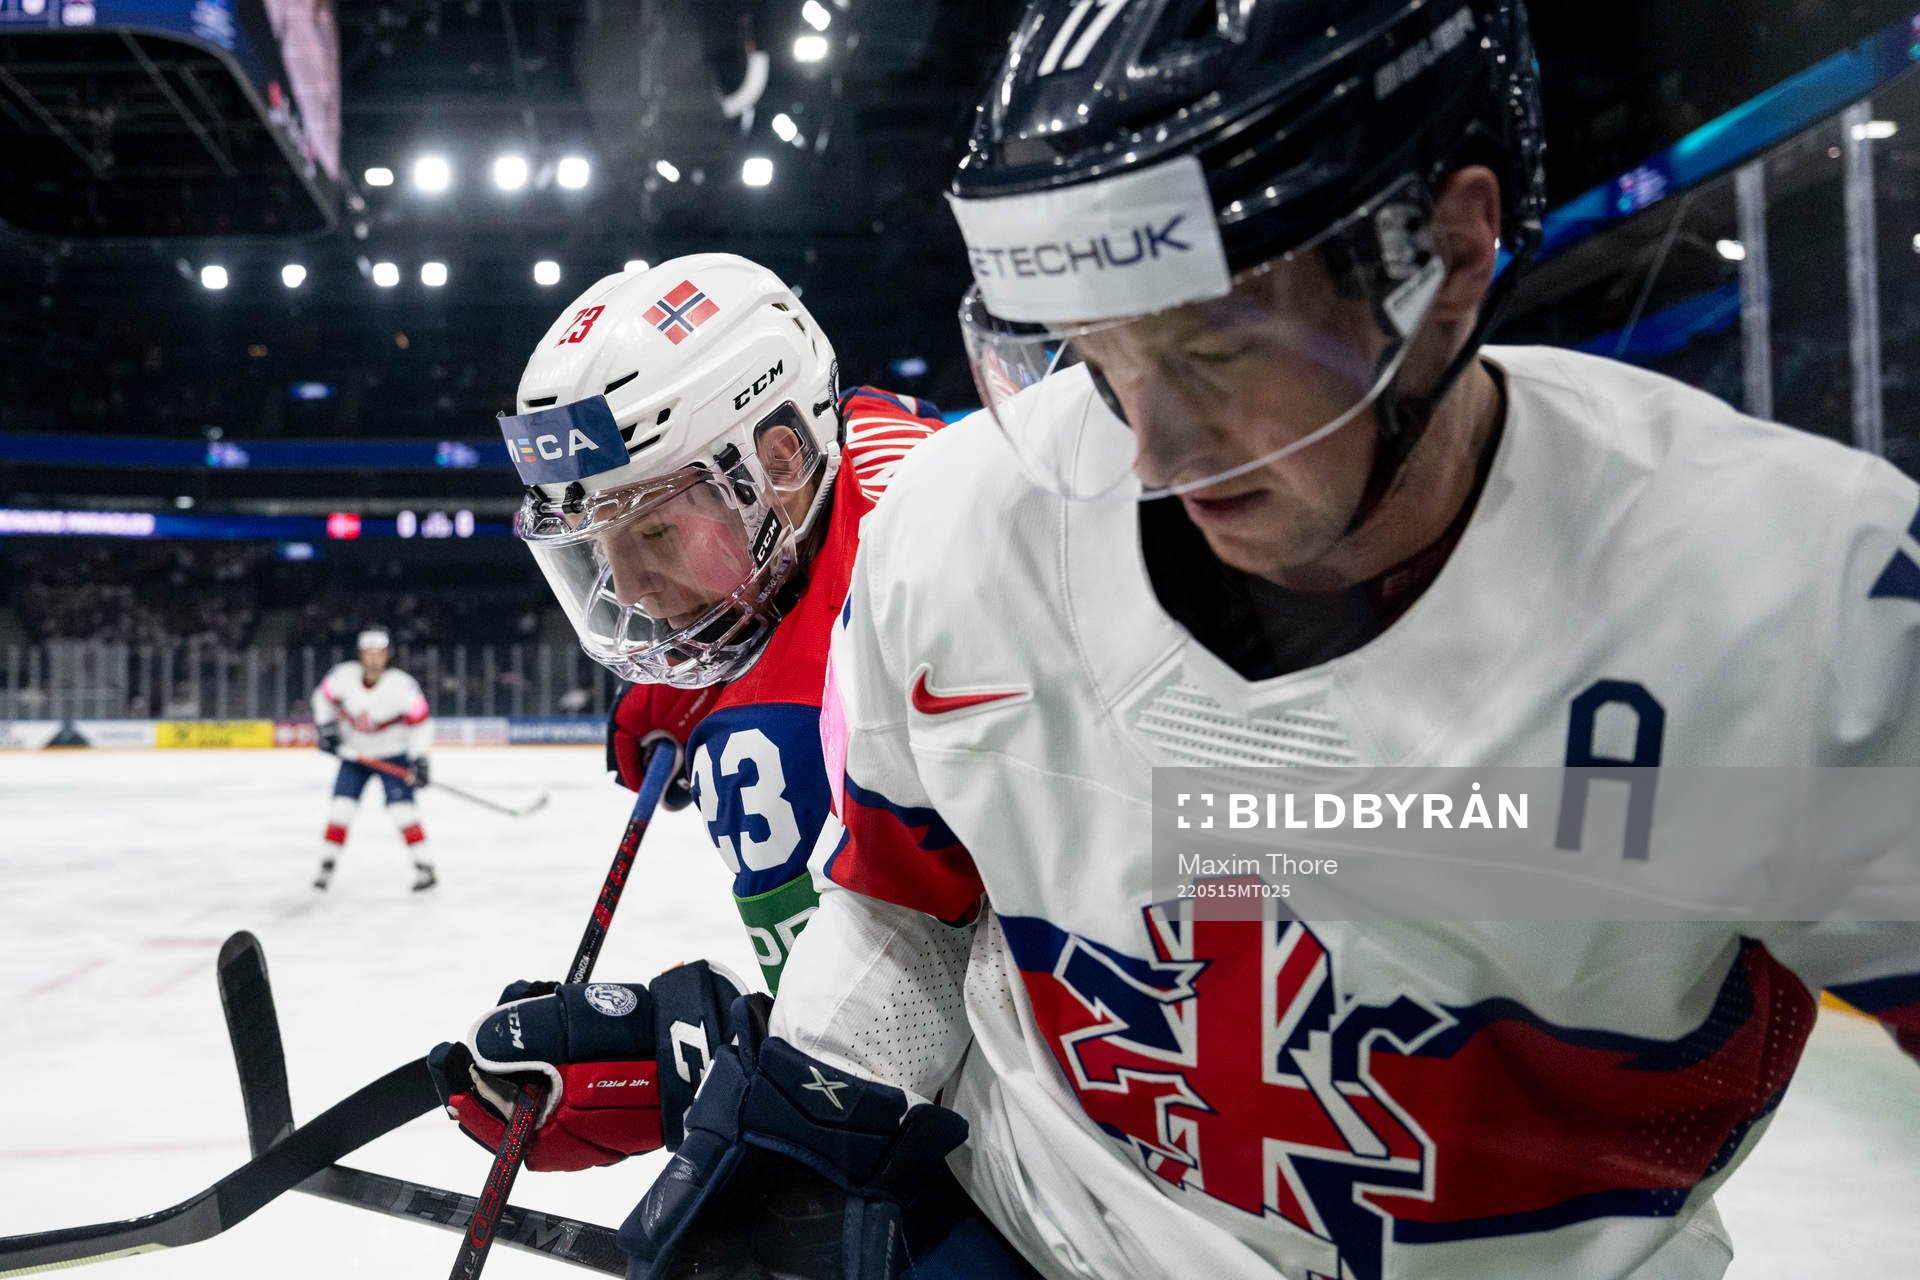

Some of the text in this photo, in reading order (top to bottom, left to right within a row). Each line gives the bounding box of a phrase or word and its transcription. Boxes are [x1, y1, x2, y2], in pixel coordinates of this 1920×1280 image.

[733, 359, 783, 410] CCM
[757, 518, 778, 562] CCM
[1555, 678, 1667, 862] A
[690, 728, 801, 874] 23
[507, 1005, 525, 1050] CM
